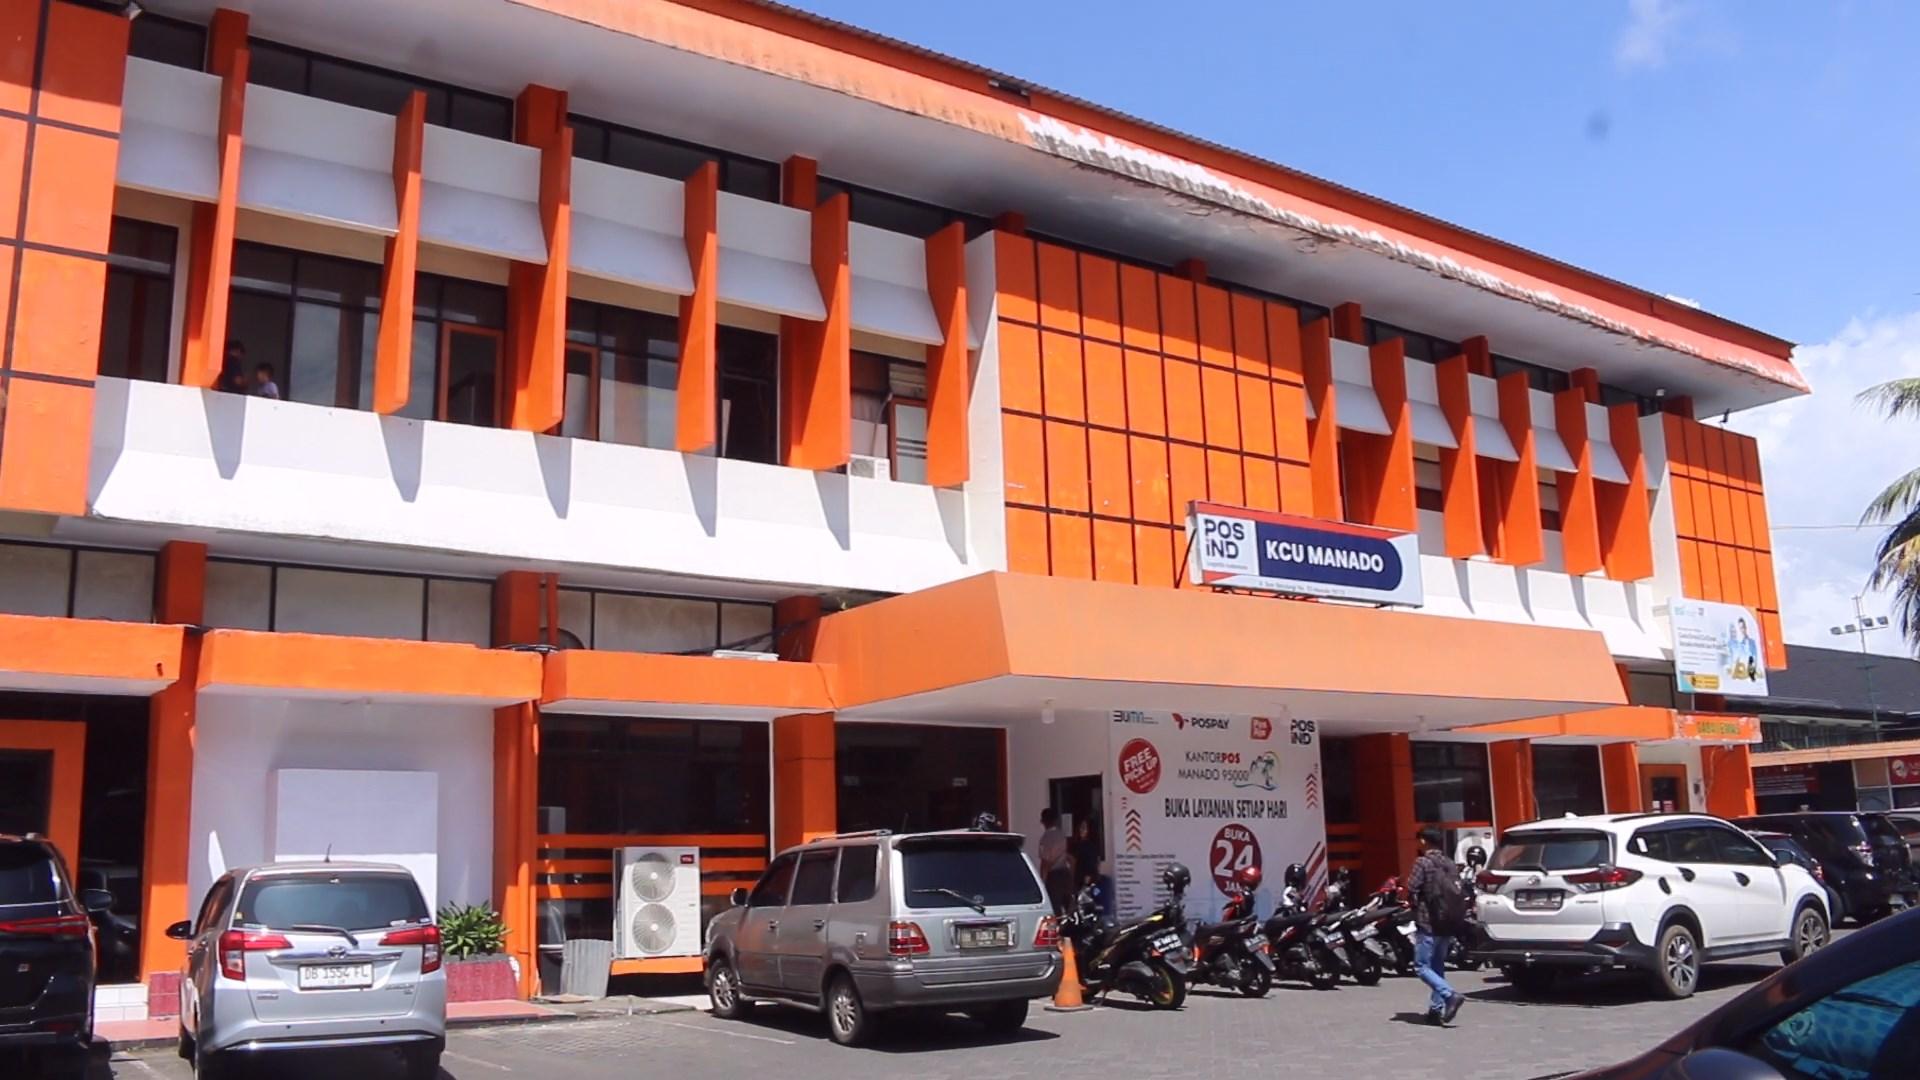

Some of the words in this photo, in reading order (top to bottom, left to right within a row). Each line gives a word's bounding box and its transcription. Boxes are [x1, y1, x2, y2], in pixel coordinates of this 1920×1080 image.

[1204, 518, 1245, 541] POS
[1266, 540, 1305, 563] KCU
[1307, 545, 1385, 573] MANADO
[1191, 717, 1230, 730] POSPAY
[1290, 719, 1316, 733] POS
[1123, 747, 1153, 773] FREE
[1123, 765, 1146, 785] PICK
[1145, 756, 1158, 771] UP
[1178, 768, 1220, 780] MANADO
[1164, 798, 1190, 818] BUKA
[1192, 798, 1234, 819] LAYANAN
[1236, 800, 1265, 819] SETIAP
[1267, 800, 1287, 819] HARI
[1224, 827, 1250, 842] BUKA
[1214, 839, 1253, 878] 24
